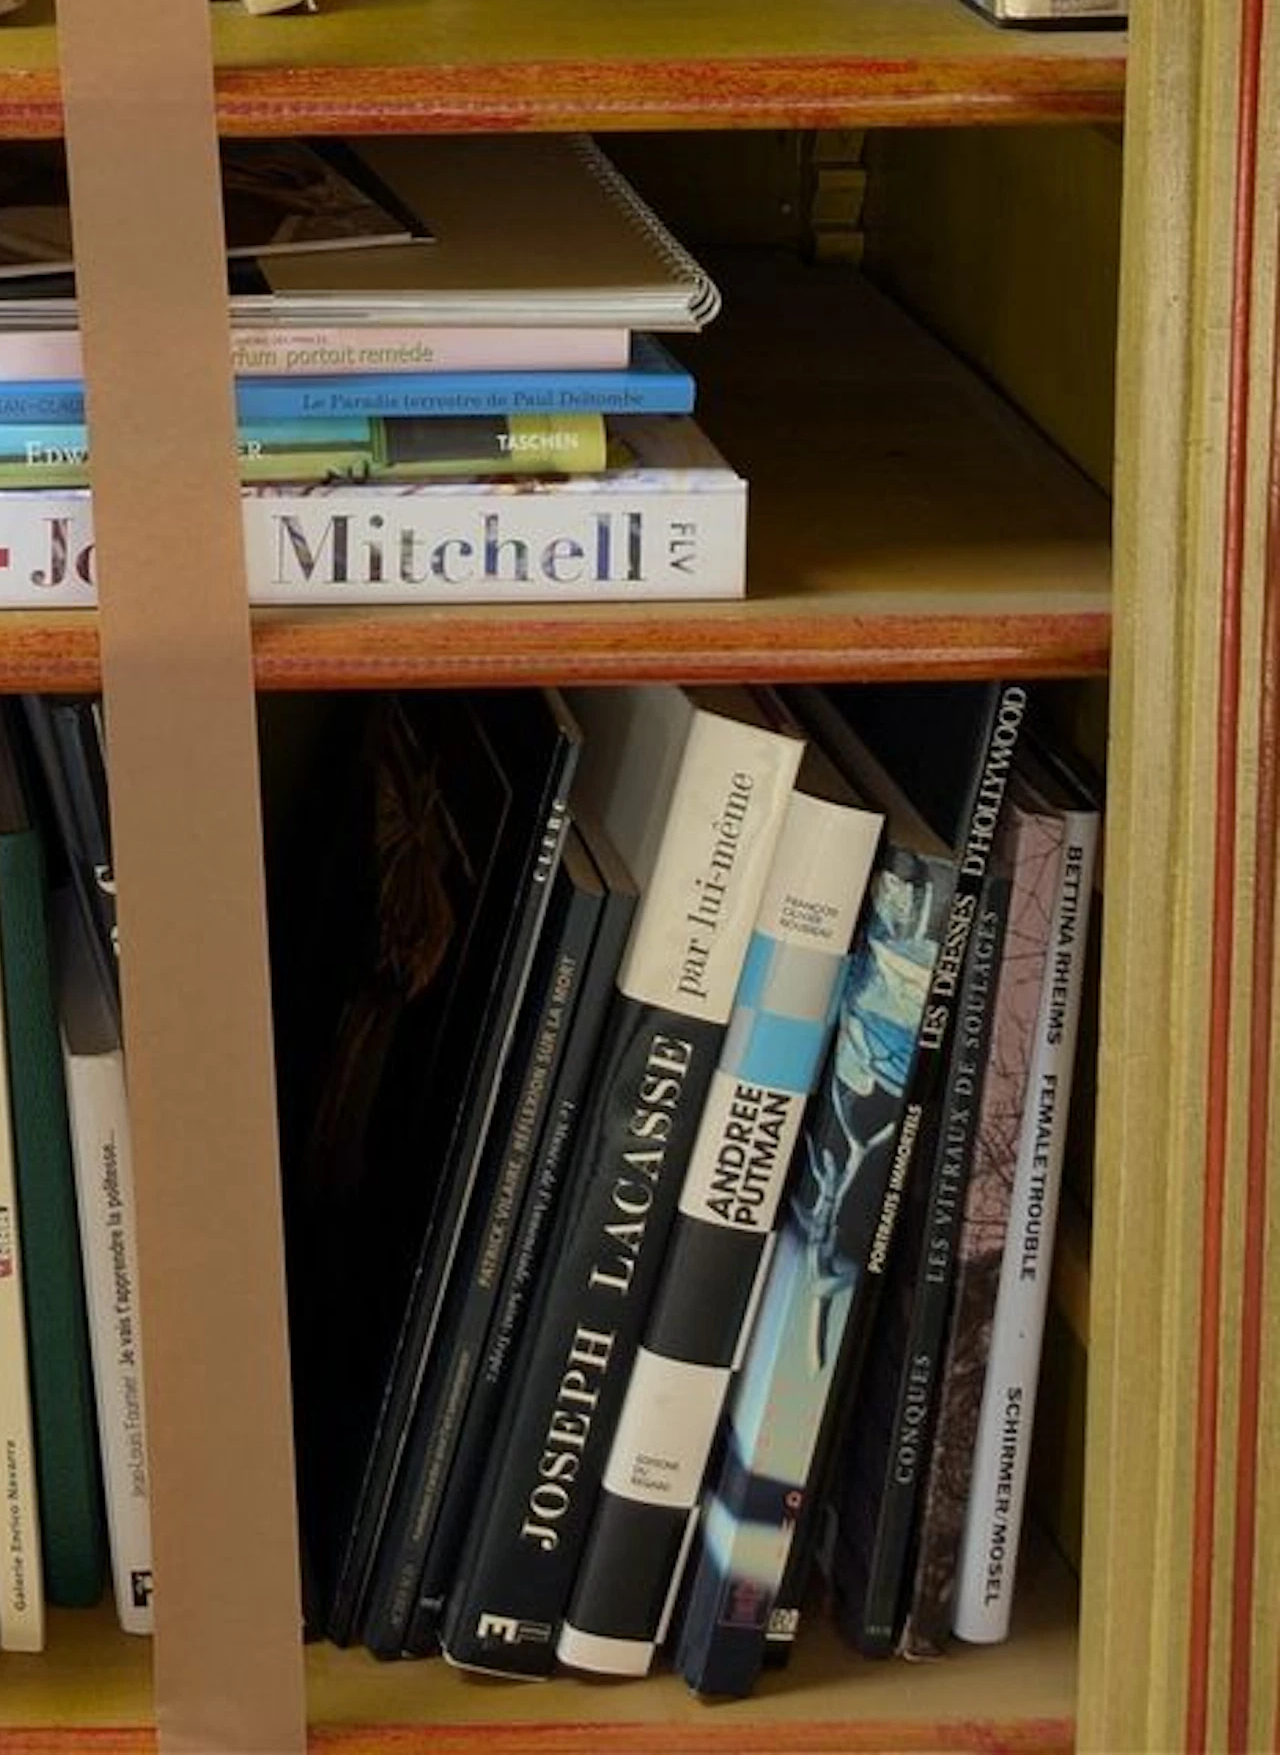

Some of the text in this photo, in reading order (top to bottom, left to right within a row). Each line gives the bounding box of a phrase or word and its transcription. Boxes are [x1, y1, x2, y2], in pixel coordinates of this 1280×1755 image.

[270, 511, 648, 587] Mitchell
[669, 522, 697, 574] FLV
[675, 769, 757, 1001] par lui-même
[1059, 844, 1085, 946] BETTINA
[703, 1082, 765, 1221] ANDREE
[732, 1089, 793, 1227] PUTMAN
[518, 1033, 695, 1552] JOSEPH LACASSE
[896, 1352, 931, 1488] CONQUES
[984, 1386, 1023, 1607] SCHIRMER/MOSEL
